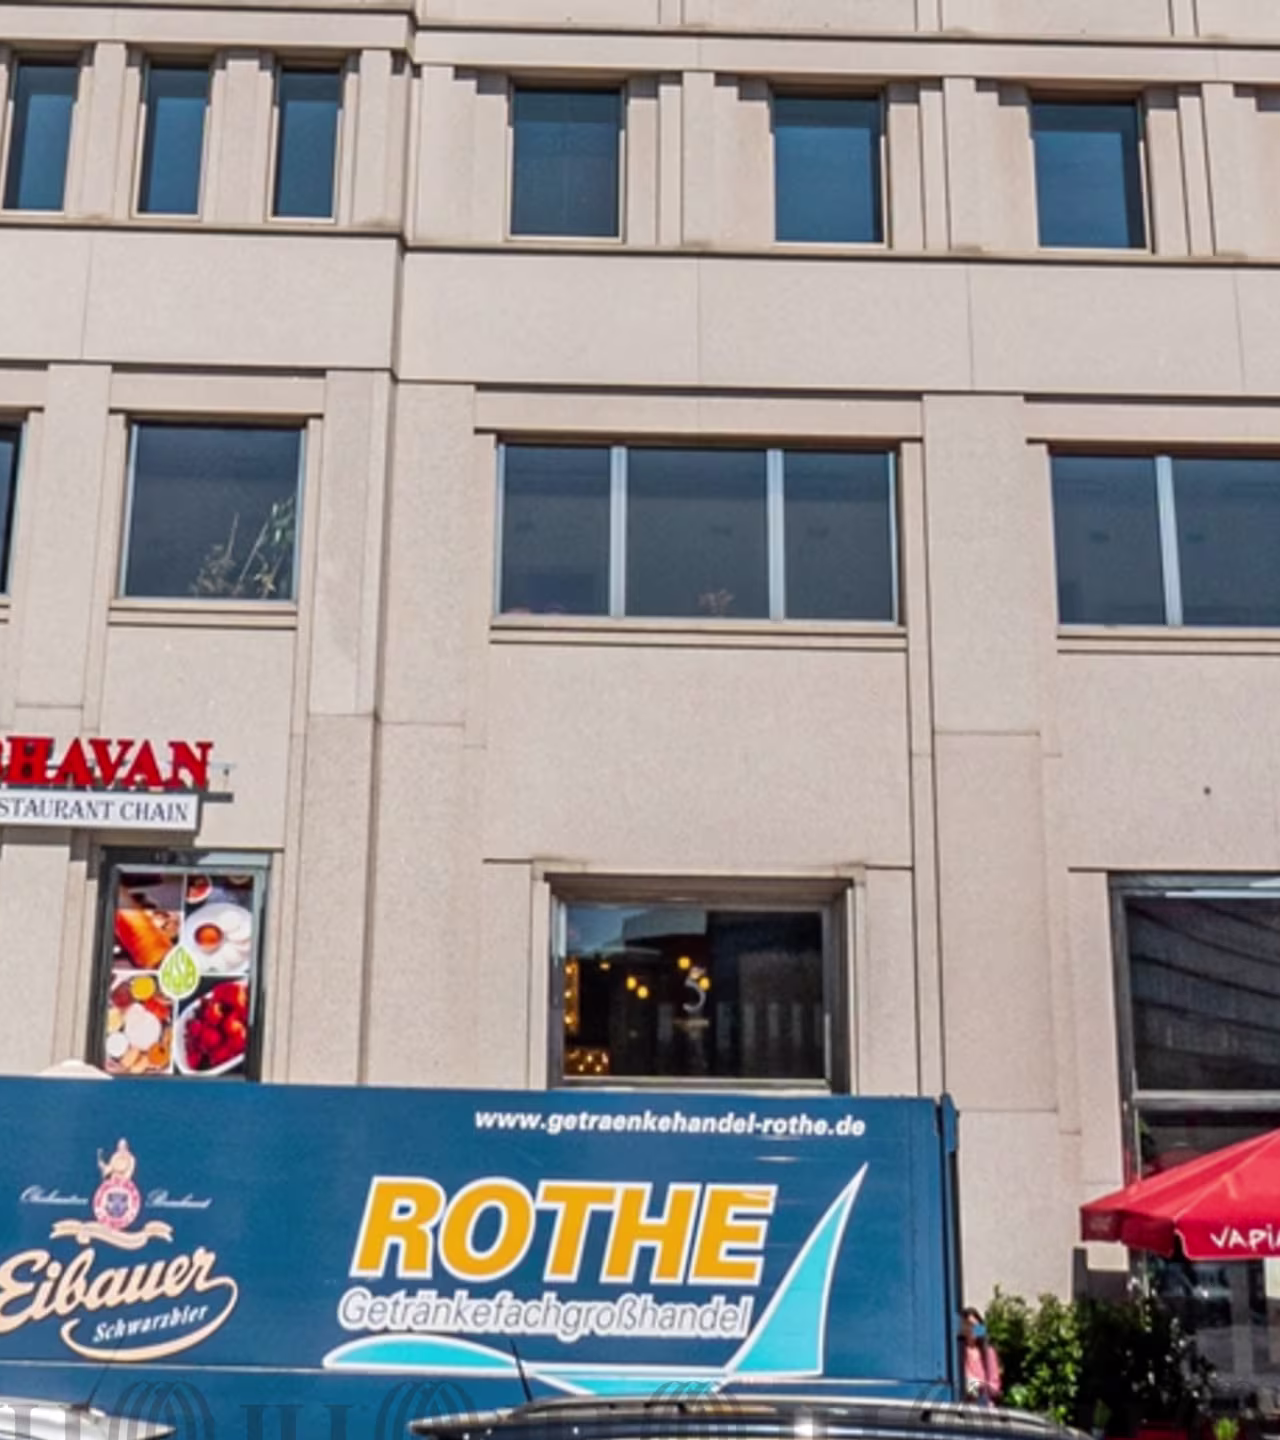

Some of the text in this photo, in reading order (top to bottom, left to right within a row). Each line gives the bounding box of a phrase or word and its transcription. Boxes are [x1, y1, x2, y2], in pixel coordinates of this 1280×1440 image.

[119, 799, 191, 822] CHAIN
[475, 1108, 866, 1138] www.getraenkehandel-rothe.de
[349, 1175, 777, 1286] ROTHE
[93, 1304, 209, 1343] Schwarzbier
[338, 1287, 753, 1342] Getränkefachgroßhandel
